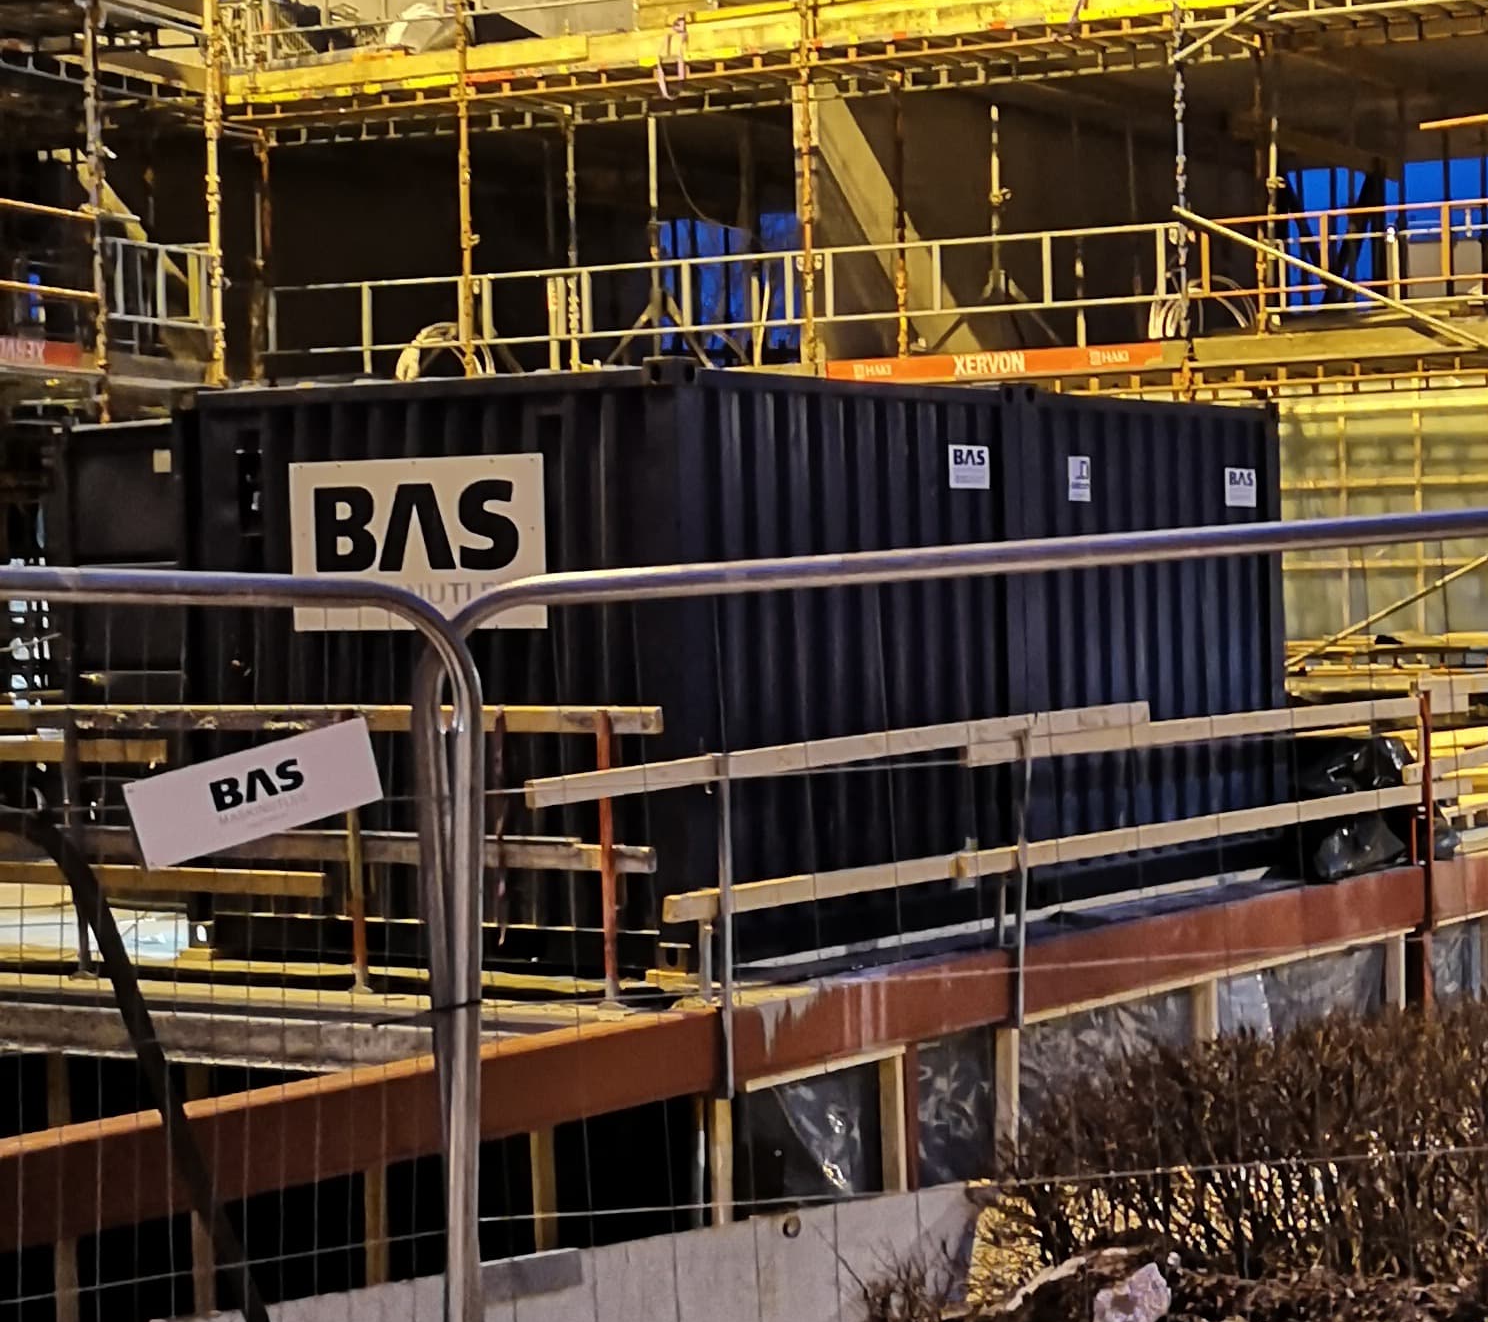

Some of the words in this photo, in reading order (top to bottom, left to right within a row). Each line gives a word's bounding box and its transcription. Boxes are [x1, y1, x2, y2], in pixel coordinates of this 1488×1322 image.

[953, 351, 1025, 375] XERVON
[952, 449, 985, 465] BAS
[1229, 471, 1254, 486] BAS
[314, 479, 519, 572] BAS
[209, 758, 304, 812] BAS
